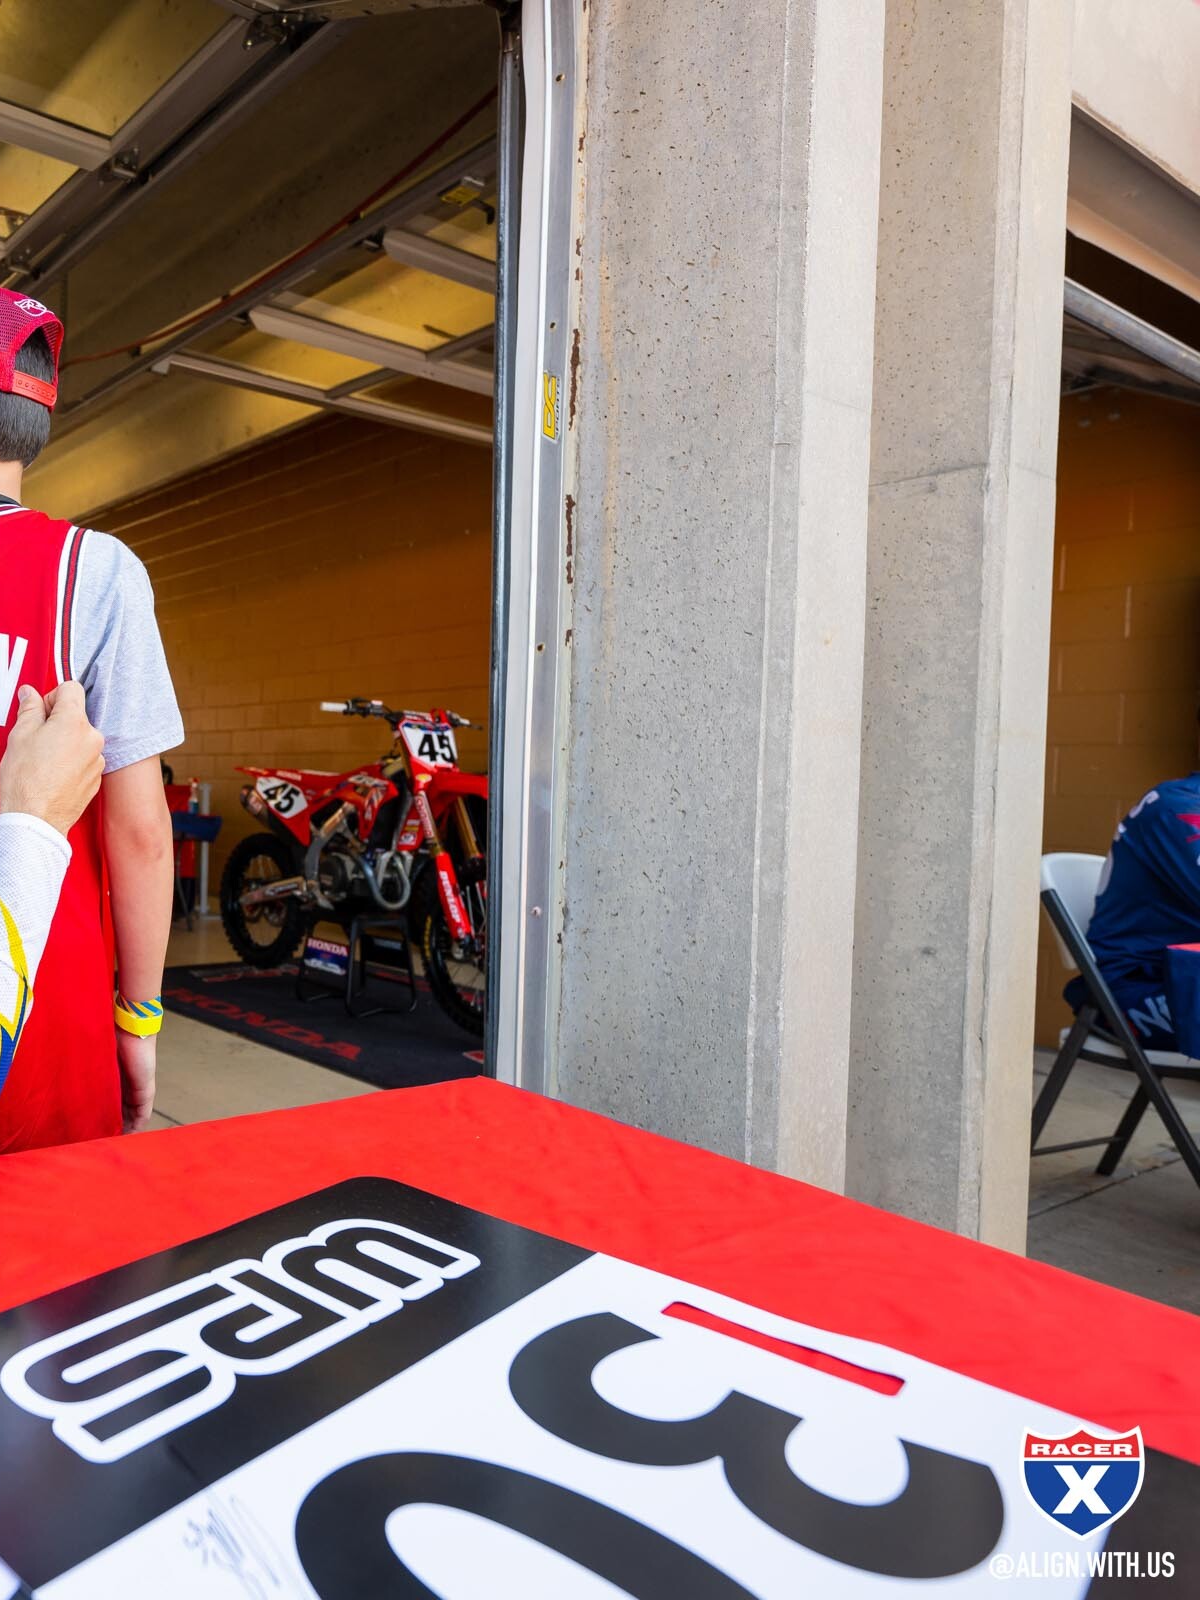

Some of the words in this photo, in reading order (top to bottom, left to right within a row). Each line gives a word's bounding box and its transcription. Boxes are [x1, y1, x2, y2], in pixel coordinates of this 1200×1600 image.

[418, 733, 456, 763] 45
[263, 782, 300, 813] 45
[307, 938, 348, 957] HONDA
[161, 988, 361, 1061] HONDA
